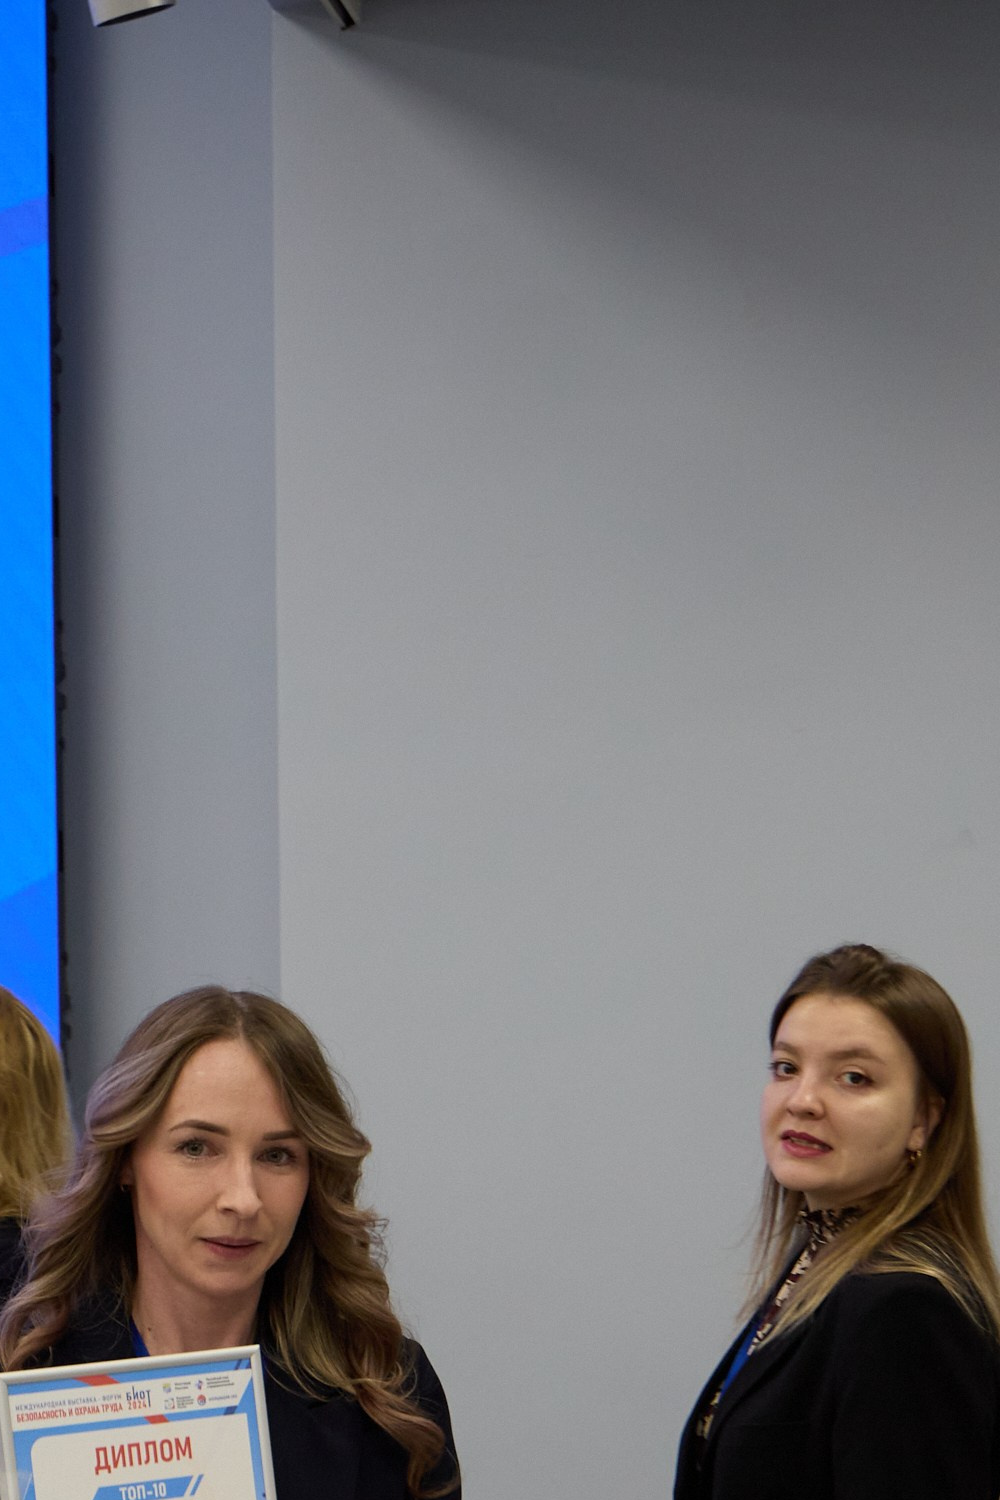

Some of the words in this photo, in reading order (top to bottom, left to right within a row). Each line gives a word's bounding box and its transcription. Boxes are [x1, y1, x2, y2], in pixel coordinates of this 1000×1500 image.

[126, 1385, 151, 1408] БИОТ
[16, 1410, 66, 1423] БЕЗОПАСНОСТЬ
[68, 1408, 74, 1416] И
[74, 1405, 100, 1416] ОХРАНА
[102, 1403, 123, 1413] ТРУДА
[128, 1401, 147, 1411] 2024
[94, 1436, 193, 1475] ДИПЛОМ
